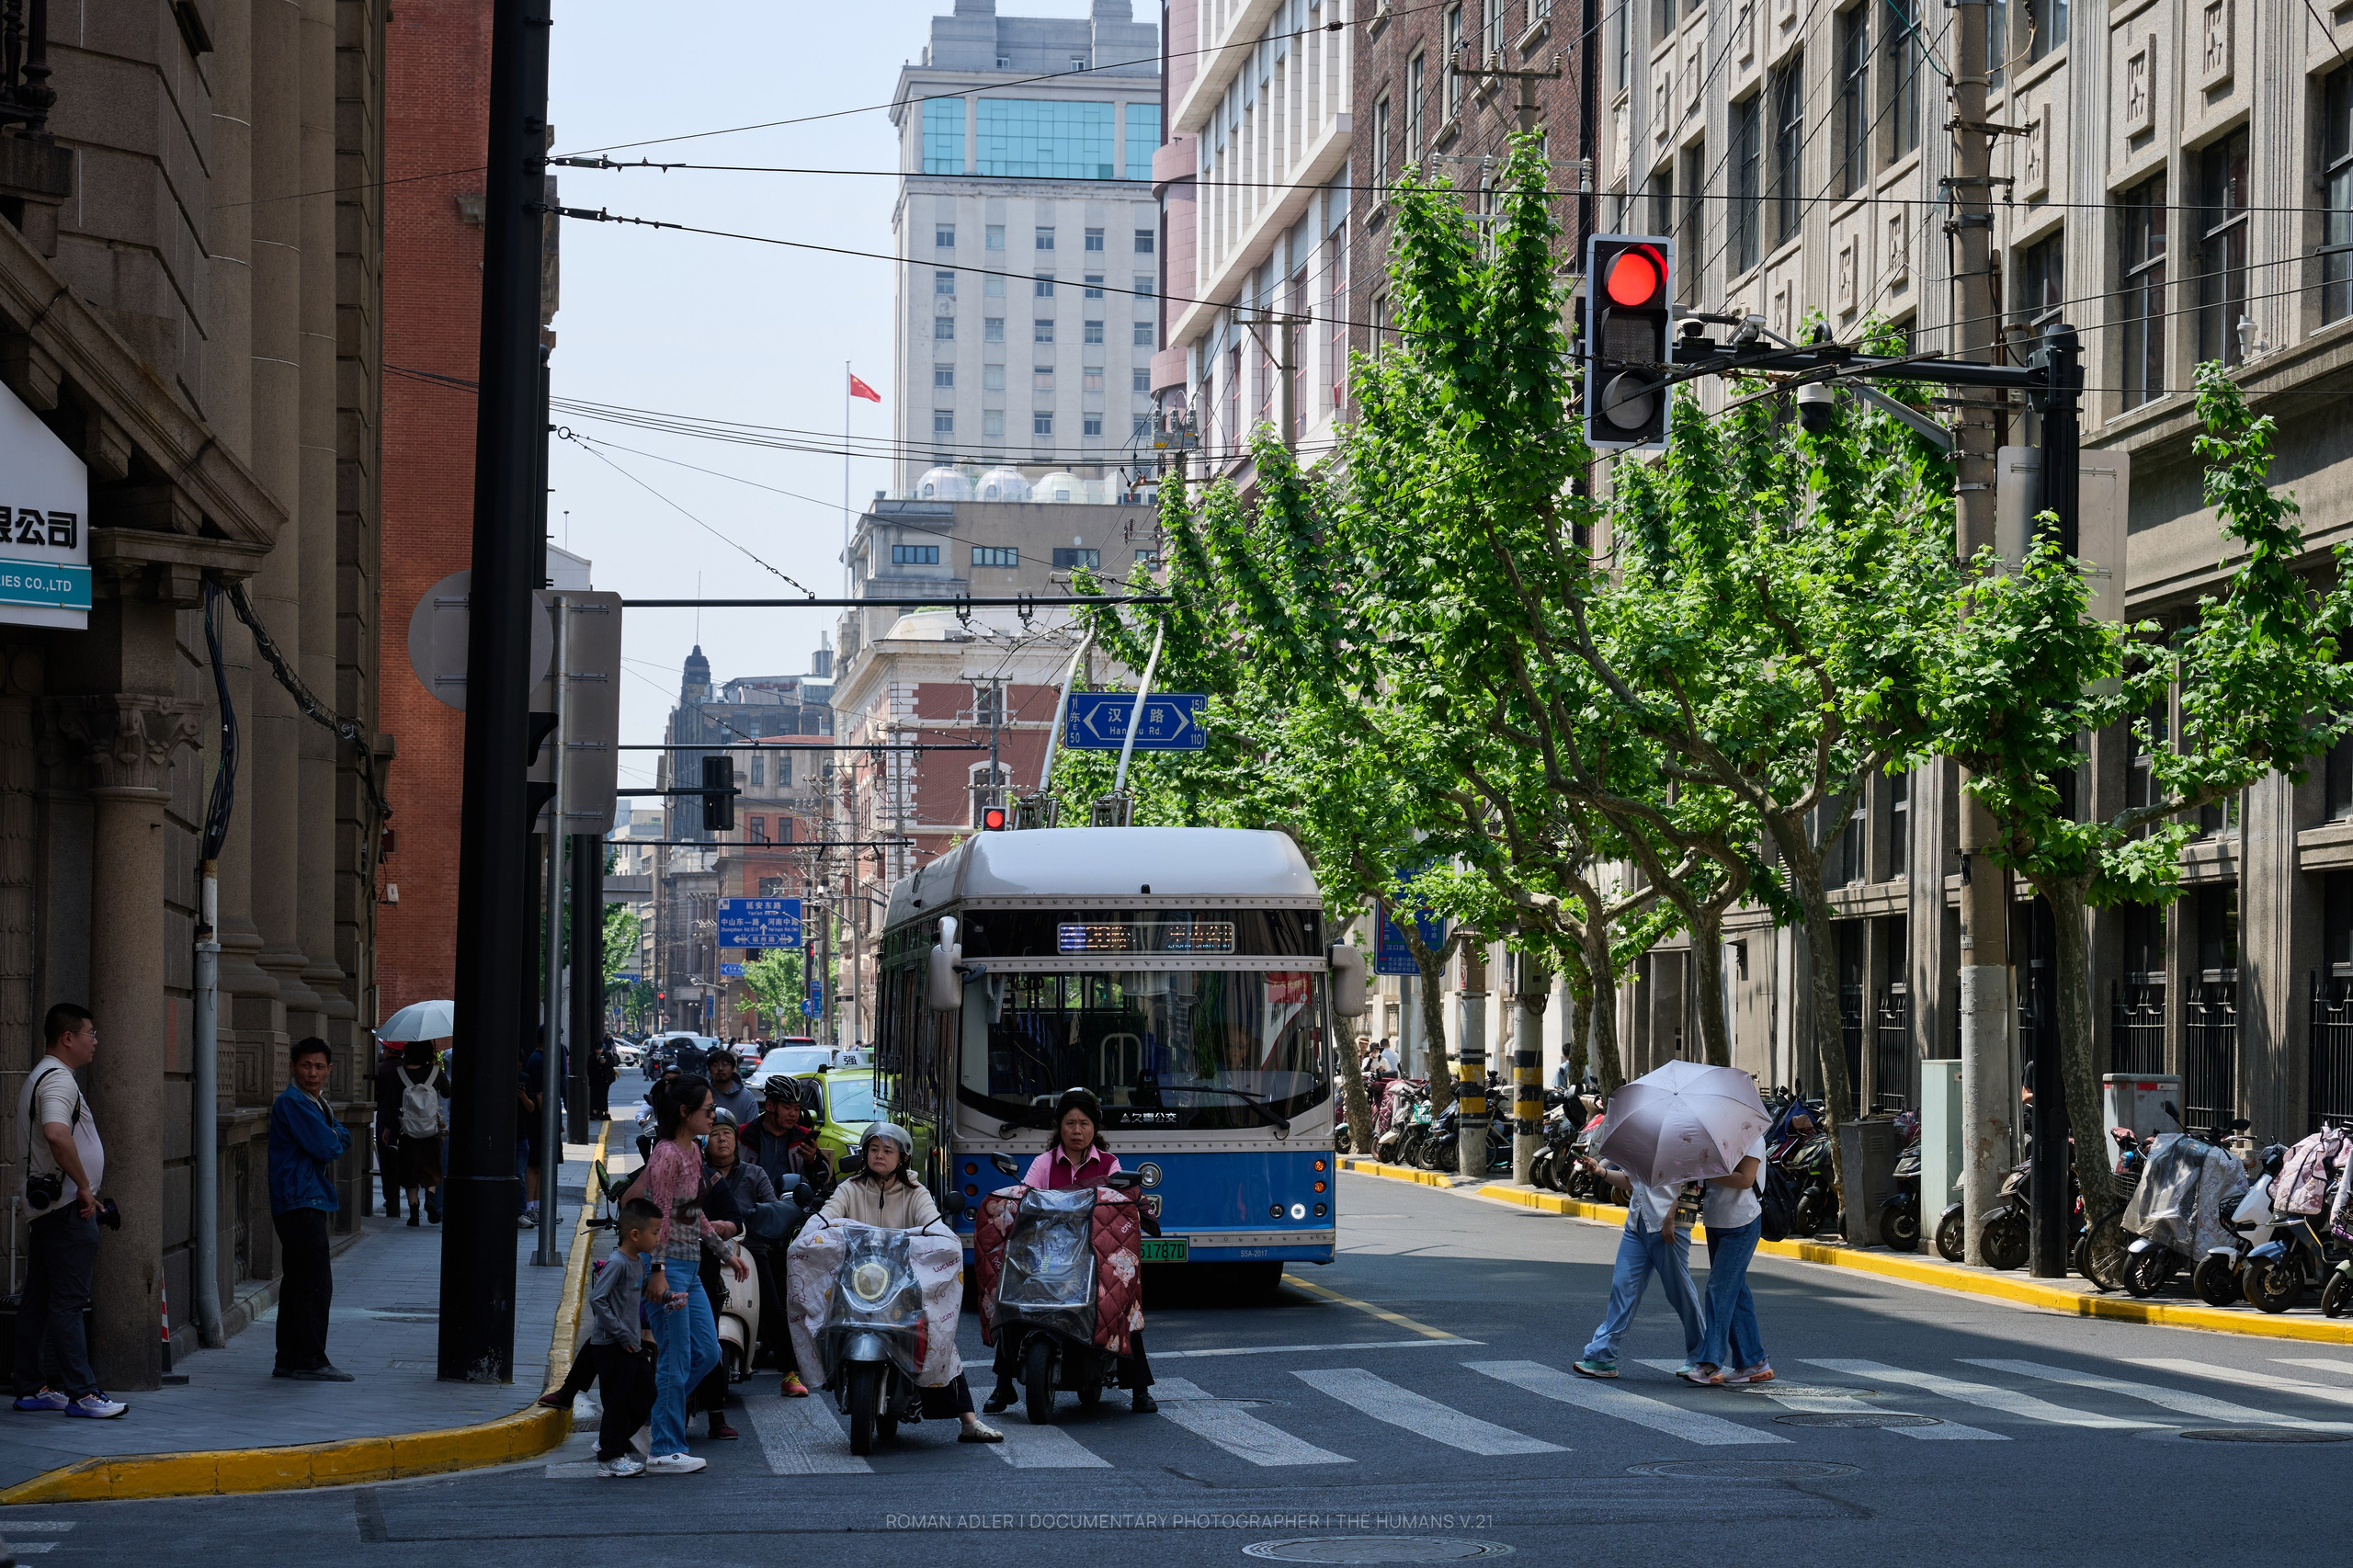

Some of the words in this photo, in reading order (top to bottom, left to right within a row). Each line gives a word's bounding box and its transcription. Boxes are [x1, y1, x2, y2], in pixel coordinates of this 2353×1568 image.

[0, 574, 21, 588] IES
[25, 577, 72, 592] CO.,LTD
[1191, 699, 1203, 710] 151
[1070, 711, 1081, 723] 东
[1108, 708, 1165, 723] 汉路
[1109, 726, 1143, 735] Hanu
[1149, 726, 1163, 735] Rd.
[1070, 732, 1081, 744] 50
[1190, 733, 1202, 745] 110
[745, 901, 781, 910] 延安东路
[843, 1055, 858, 1065] 强
[1141, 1244, 1185, 1258] 51787D
[1240, 1249, 1268, 1257] S5A-2017
